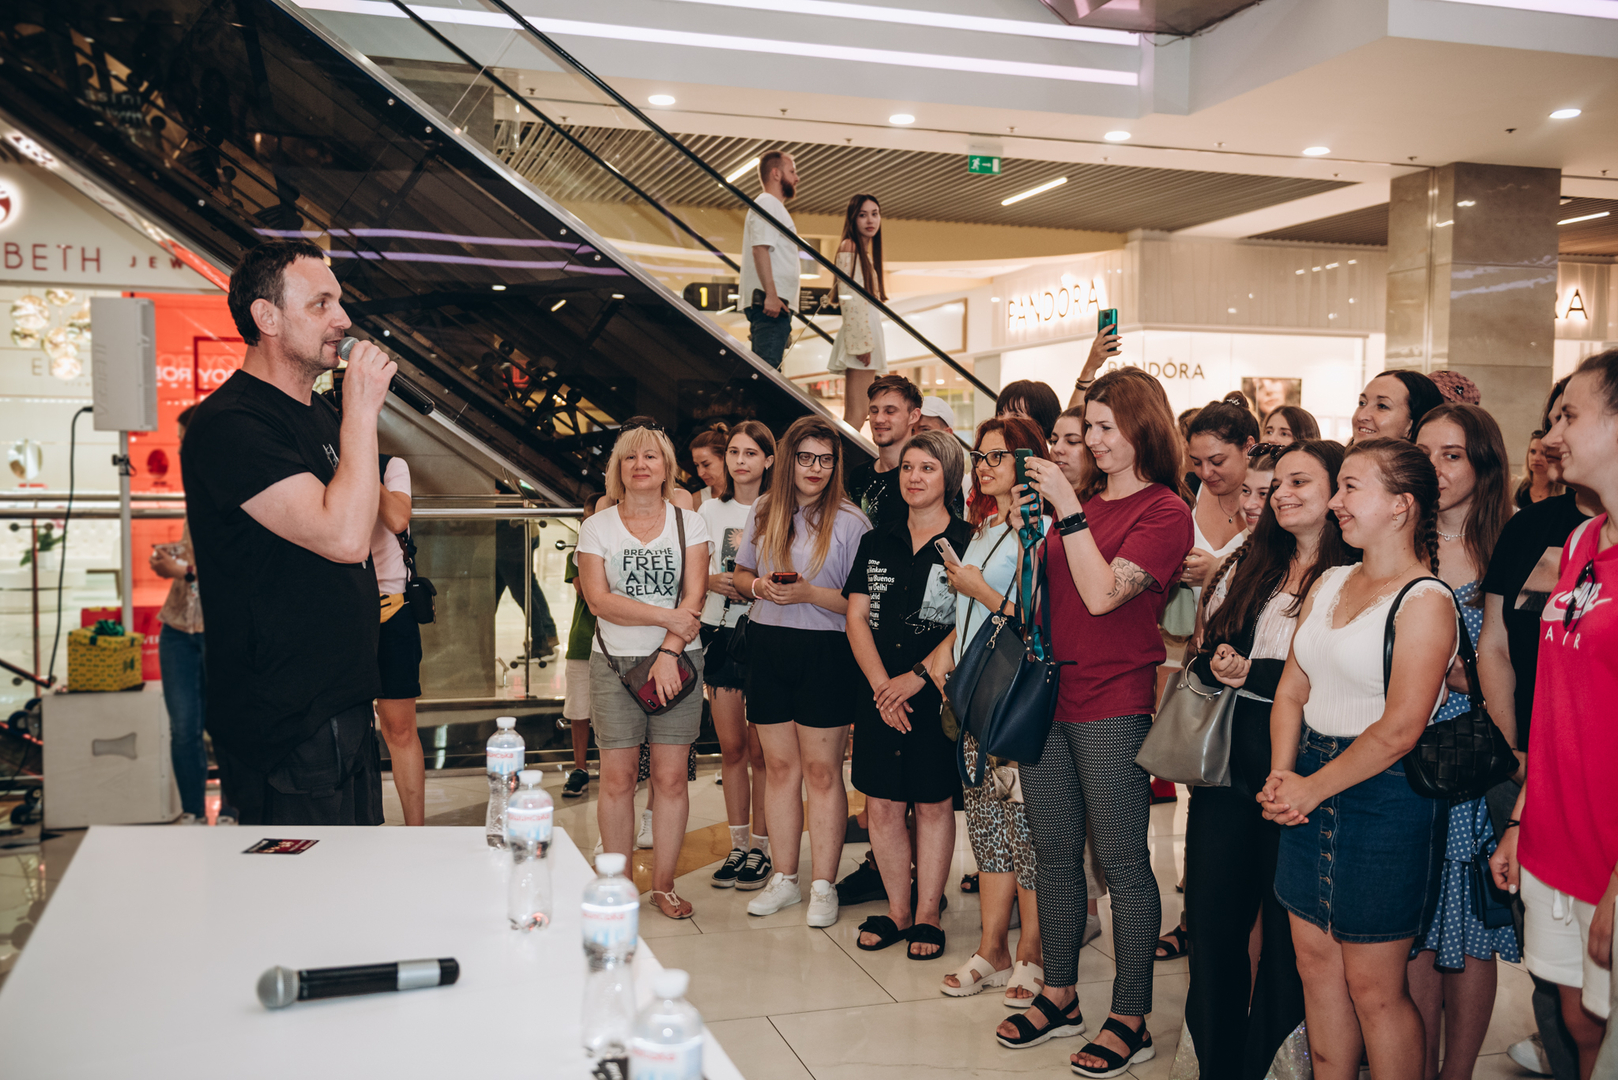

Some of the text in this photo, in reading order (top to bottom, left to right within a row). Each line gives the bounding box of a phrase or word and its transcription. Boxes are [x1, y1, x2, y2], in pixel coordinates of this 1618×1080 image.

[699, 286, 708, 308] 1
[1008, 279, 1100, 329] PANDORA
[623, 547, 674, 556] BREATHE
[623, 555, 676, 571] FREE
[626, 571, 675, 585] AND
[626, 585, 674, 597] RELAX
[1545, 625, 1581, 650] AIR
